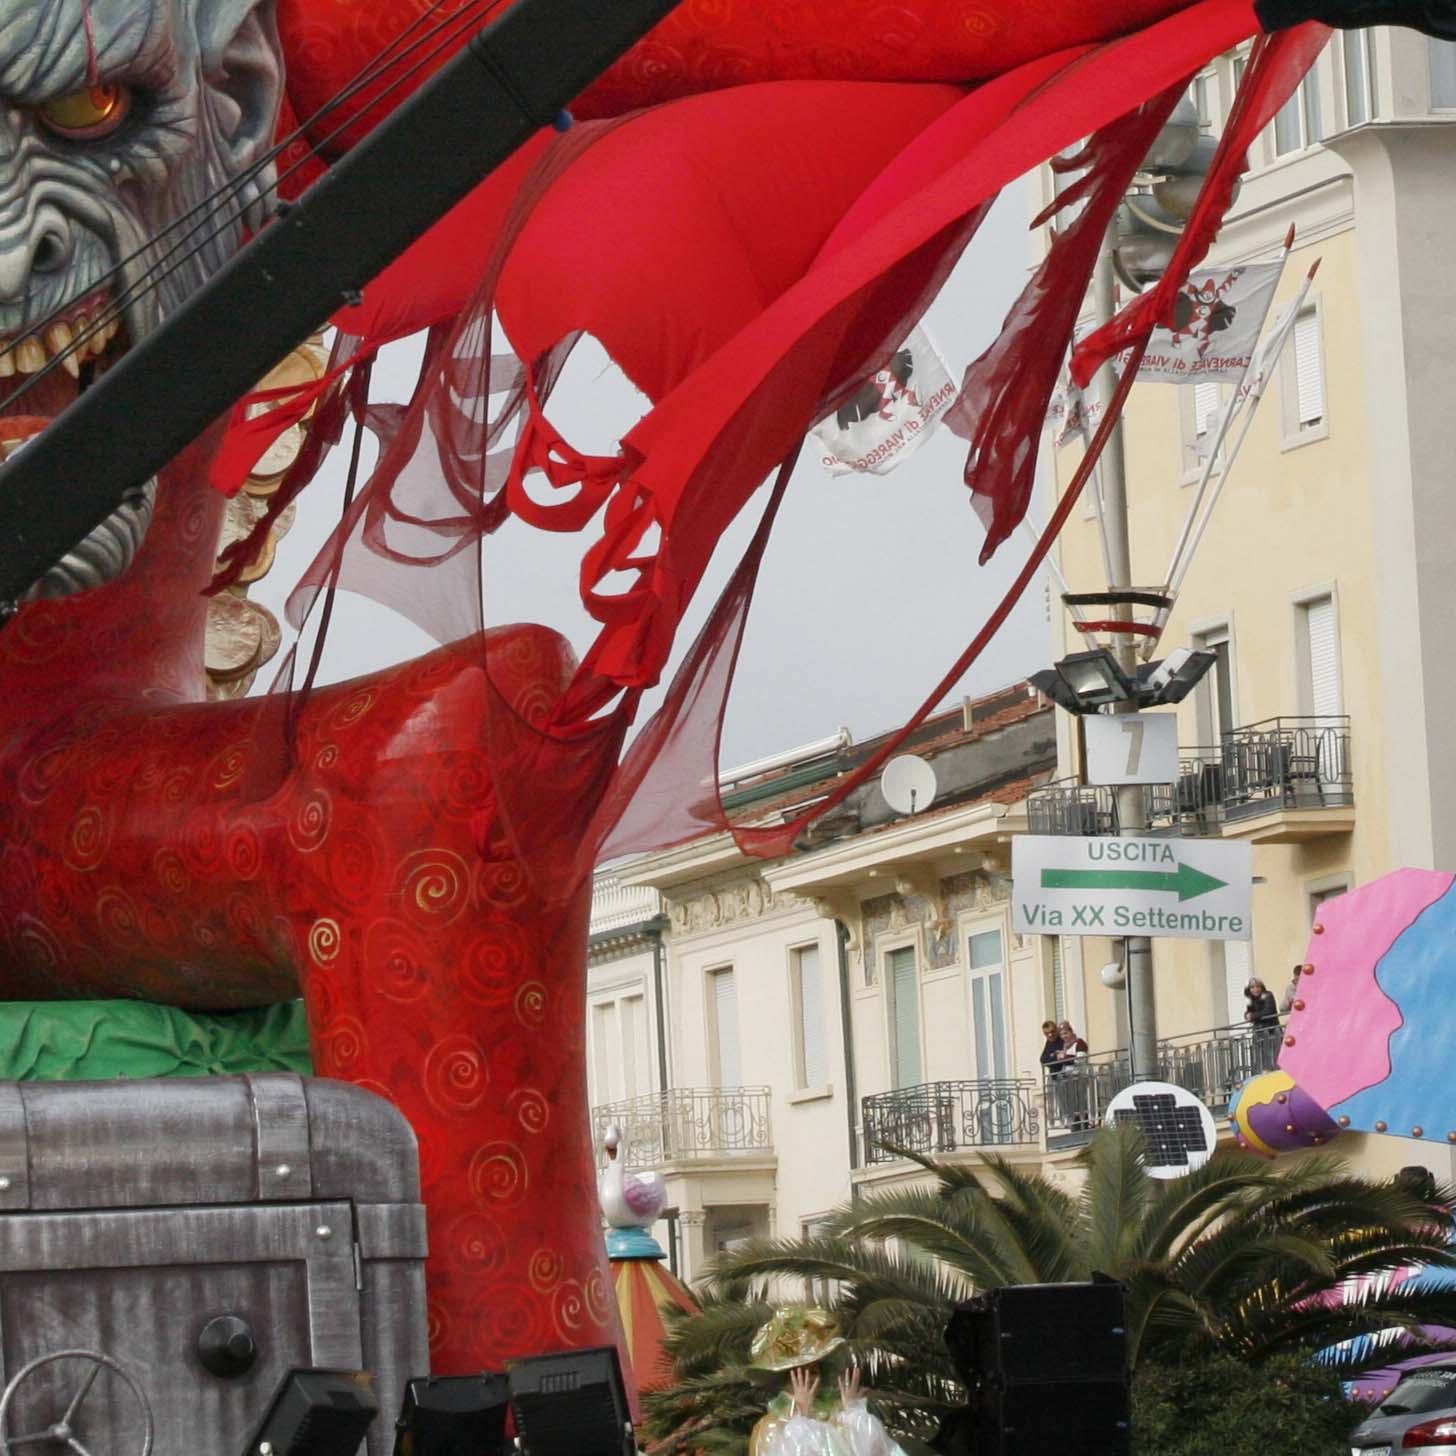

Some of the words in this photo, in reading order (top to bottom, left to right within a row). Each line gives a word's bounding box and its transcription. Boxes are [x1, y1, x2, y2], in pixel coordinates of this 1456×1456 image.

[1120, 720, 1144, 776] 7
[1088, 842, 1175, 863] USCITA
[1022, 904, 1063, 926] Via
[1071, 905, 1105, 927] XX
[1113, 905, 1243, 932] Settembre
